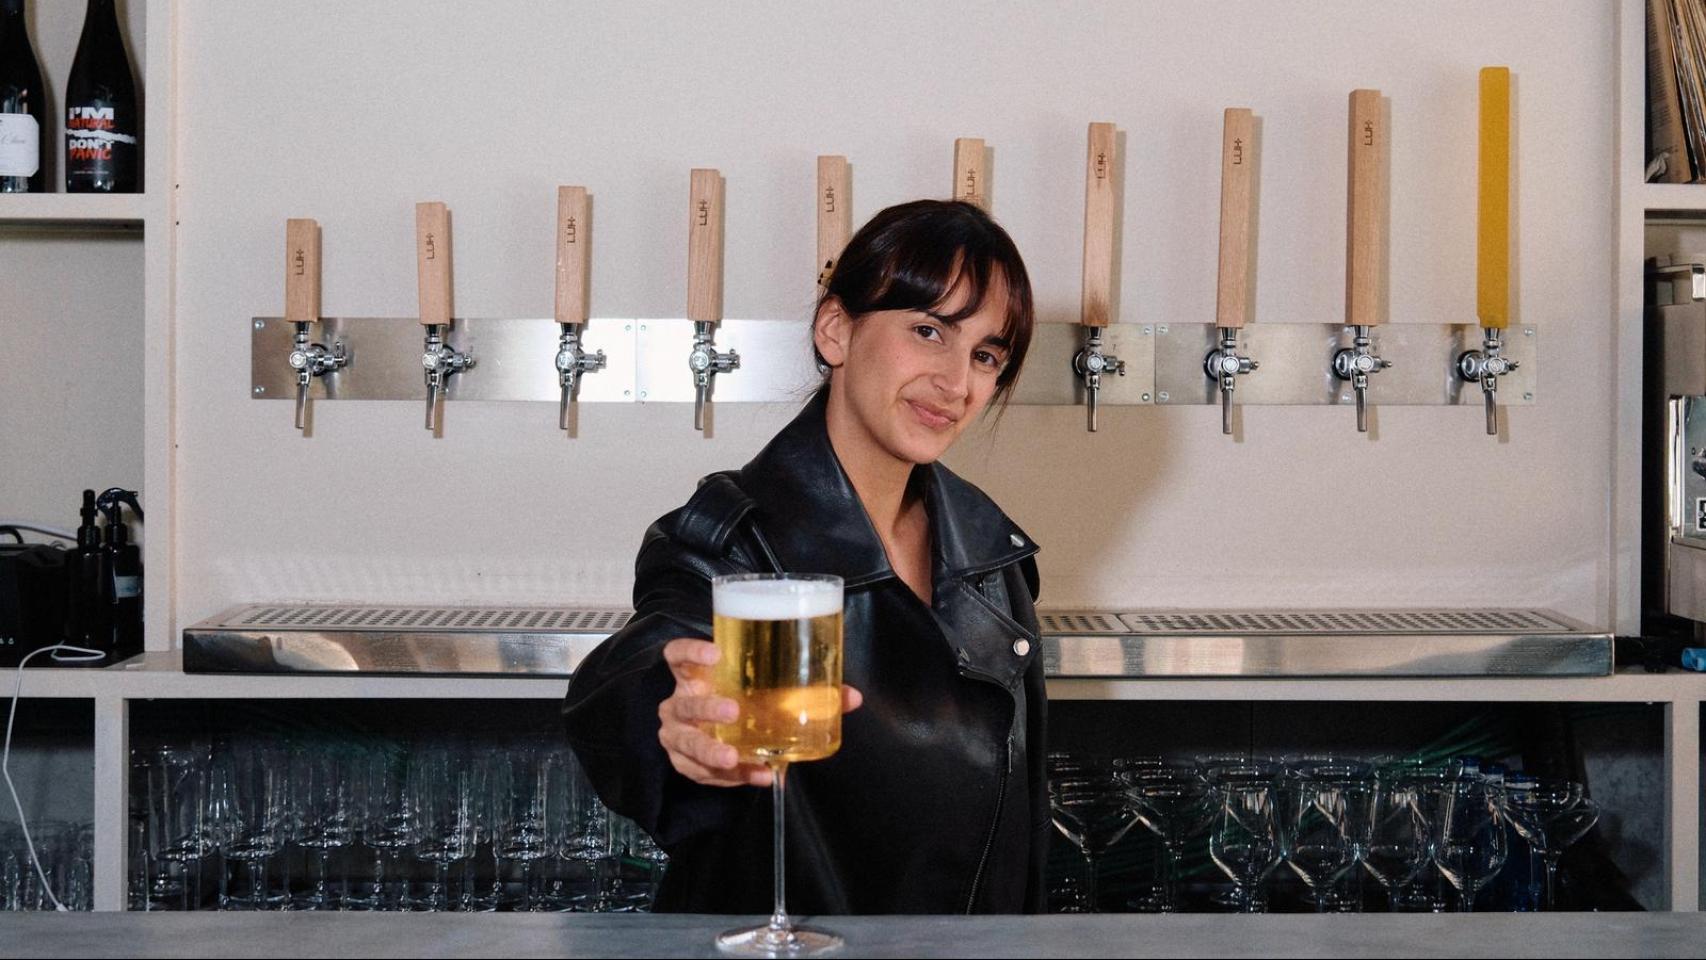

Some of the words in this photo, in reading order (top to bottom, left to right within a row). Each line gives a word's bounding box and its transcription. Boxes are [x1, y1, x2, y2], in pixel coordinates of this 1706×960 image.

[69, 107, 114, 119] I'M
[69, 139, 114, 149] DON'T
[70, 149, 112, 160] PANIC
